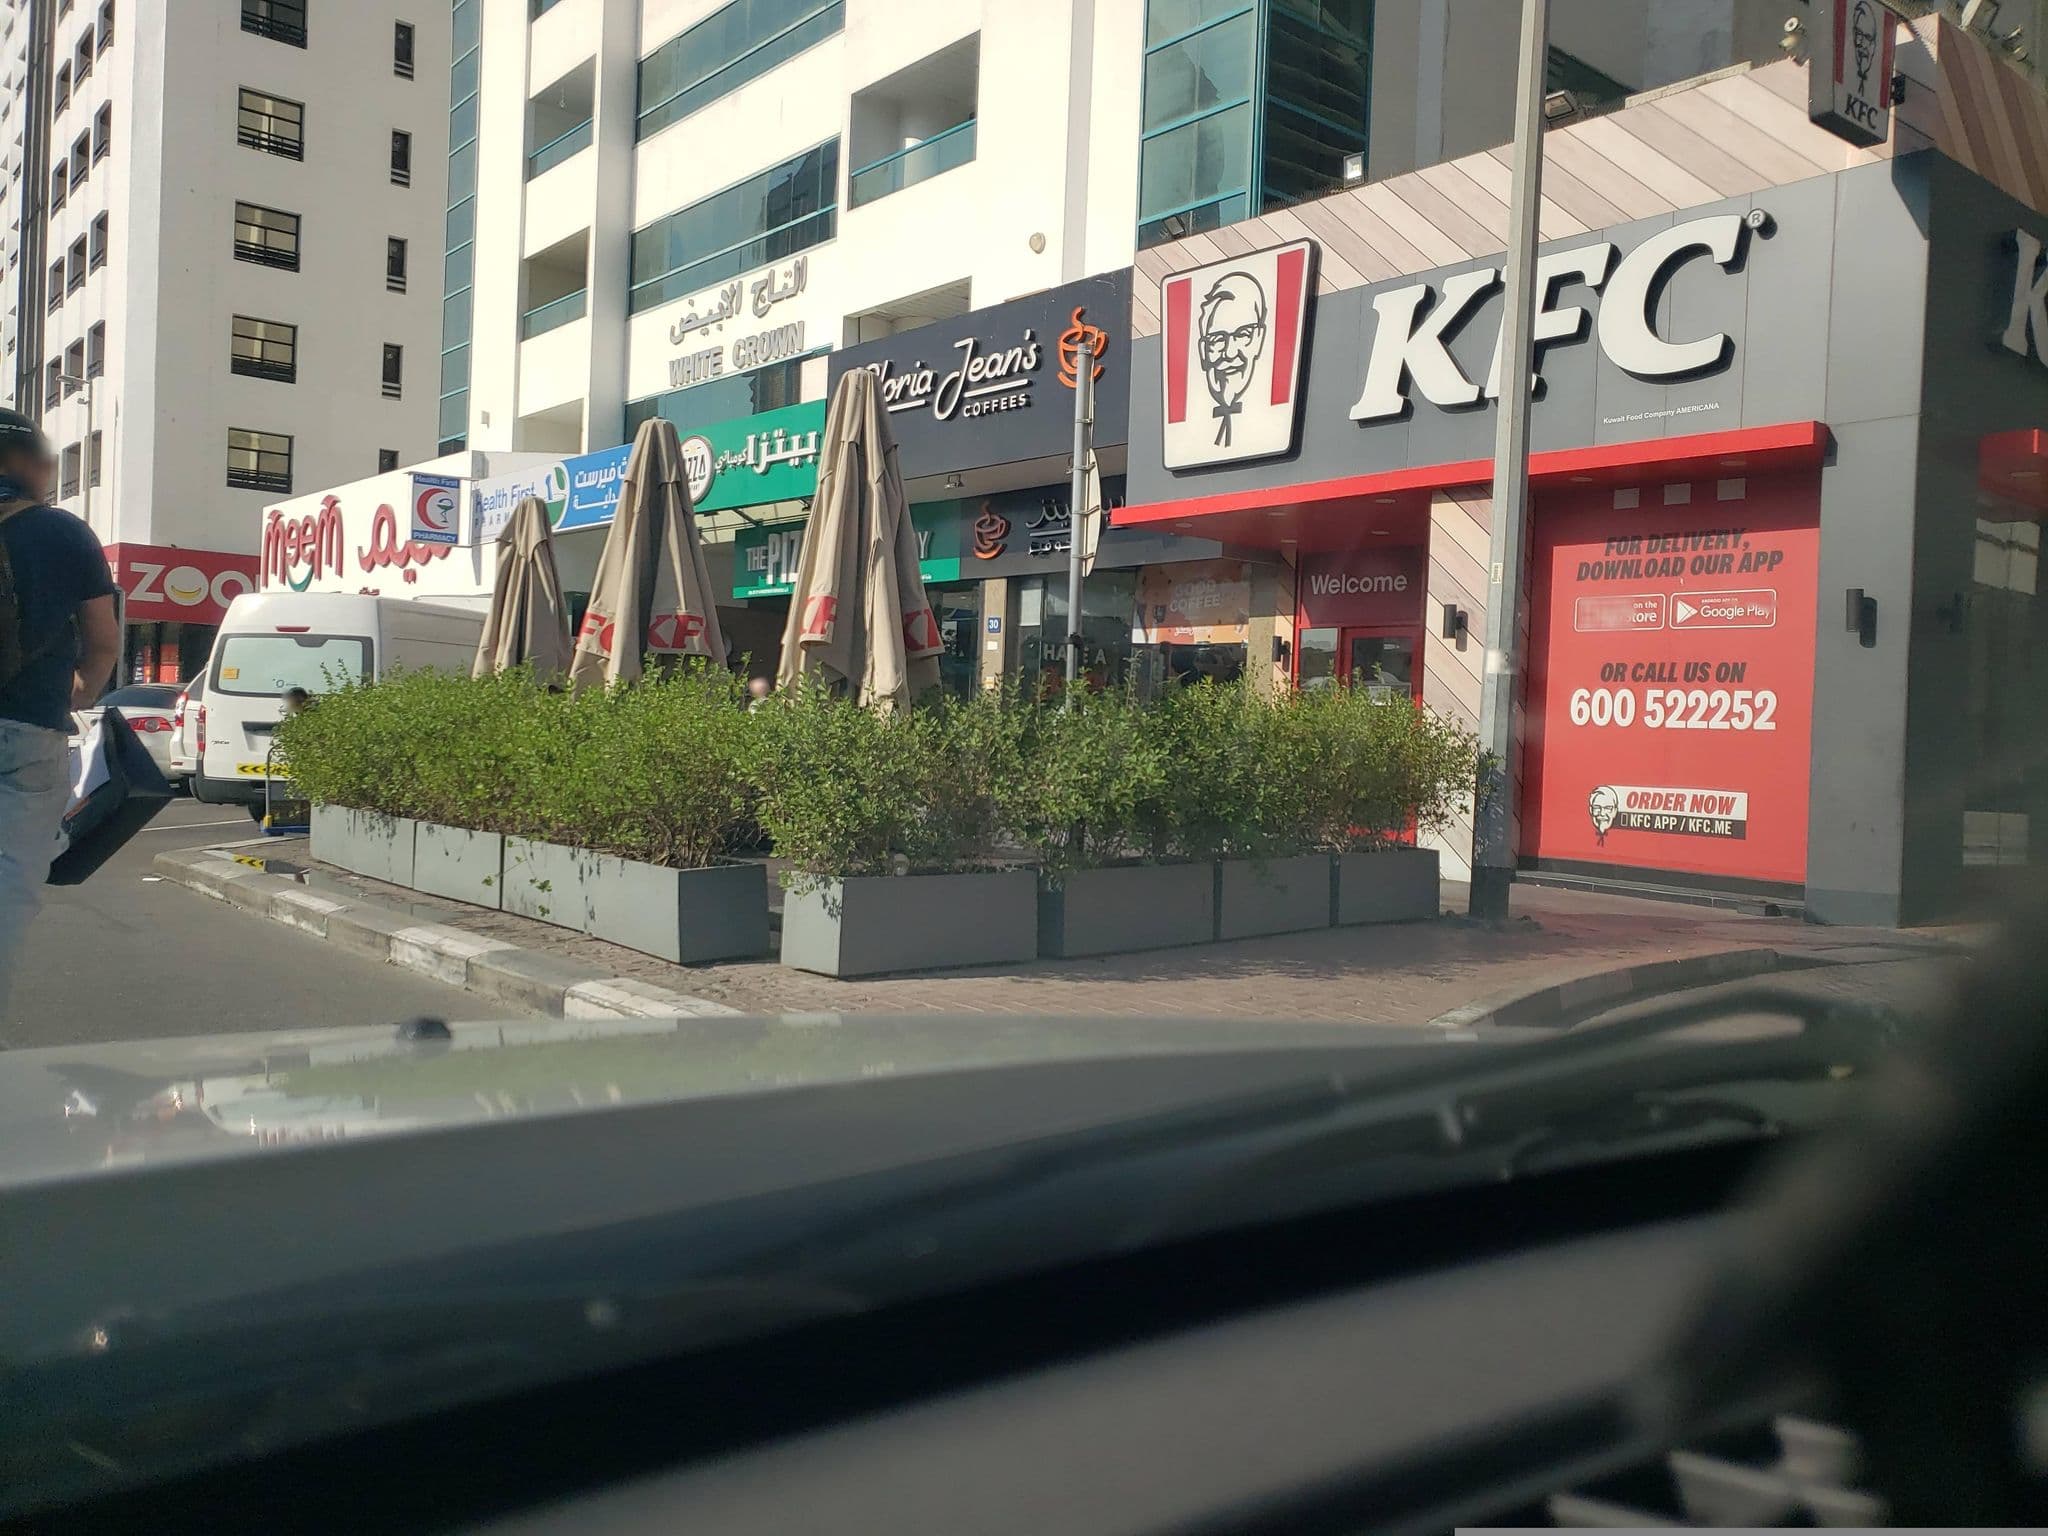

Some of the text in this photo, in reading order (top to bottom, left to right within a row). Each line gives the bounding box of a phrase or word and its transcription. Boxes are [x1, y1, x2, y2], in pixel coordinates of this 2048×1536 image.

[1844, 94, 1878, 130] KFC
[751, 256, 808, 318] التاج
[1349, 213, 1744, 421] KFC
[669, 321, 805, 387] WHITE CROWN
[866, 329, 1038, 421] loria Jean's
[963, 393, 1028, 418] COFFEES
[1603, 402, 1720, 425] Kuwait Food Company AMERICANA
[745, 428, 819, 475] بيتزا
[473, 482, 537, 514] Health First
[413, 531, 457, 542] PHARMACY
[1605, 528, 1751, 557] FOR DELIVERY,
[746, 530, 802, 585] THE PIZ
[1576, 550, 1784, 582] DOWNLOAD OUR APP
[127, 562, 261, 608] ZOO
[1311, 573, 1408, 596] Welcome
[1627, 611, 1658, 623] tore
[1644, 600, 1658, 609] the
[1700, 602, 1771, 620] Google Play
[988, 619, 999, 630] 30
[1601, 662, 1747, 683] OR CALL US ON
[1570, 688, 1778, 731] 600 522252
[1626, 791, 1736, 816] ORDER NOW
[1630, 814, 1733, 835] KFC APP / KFC.ME
